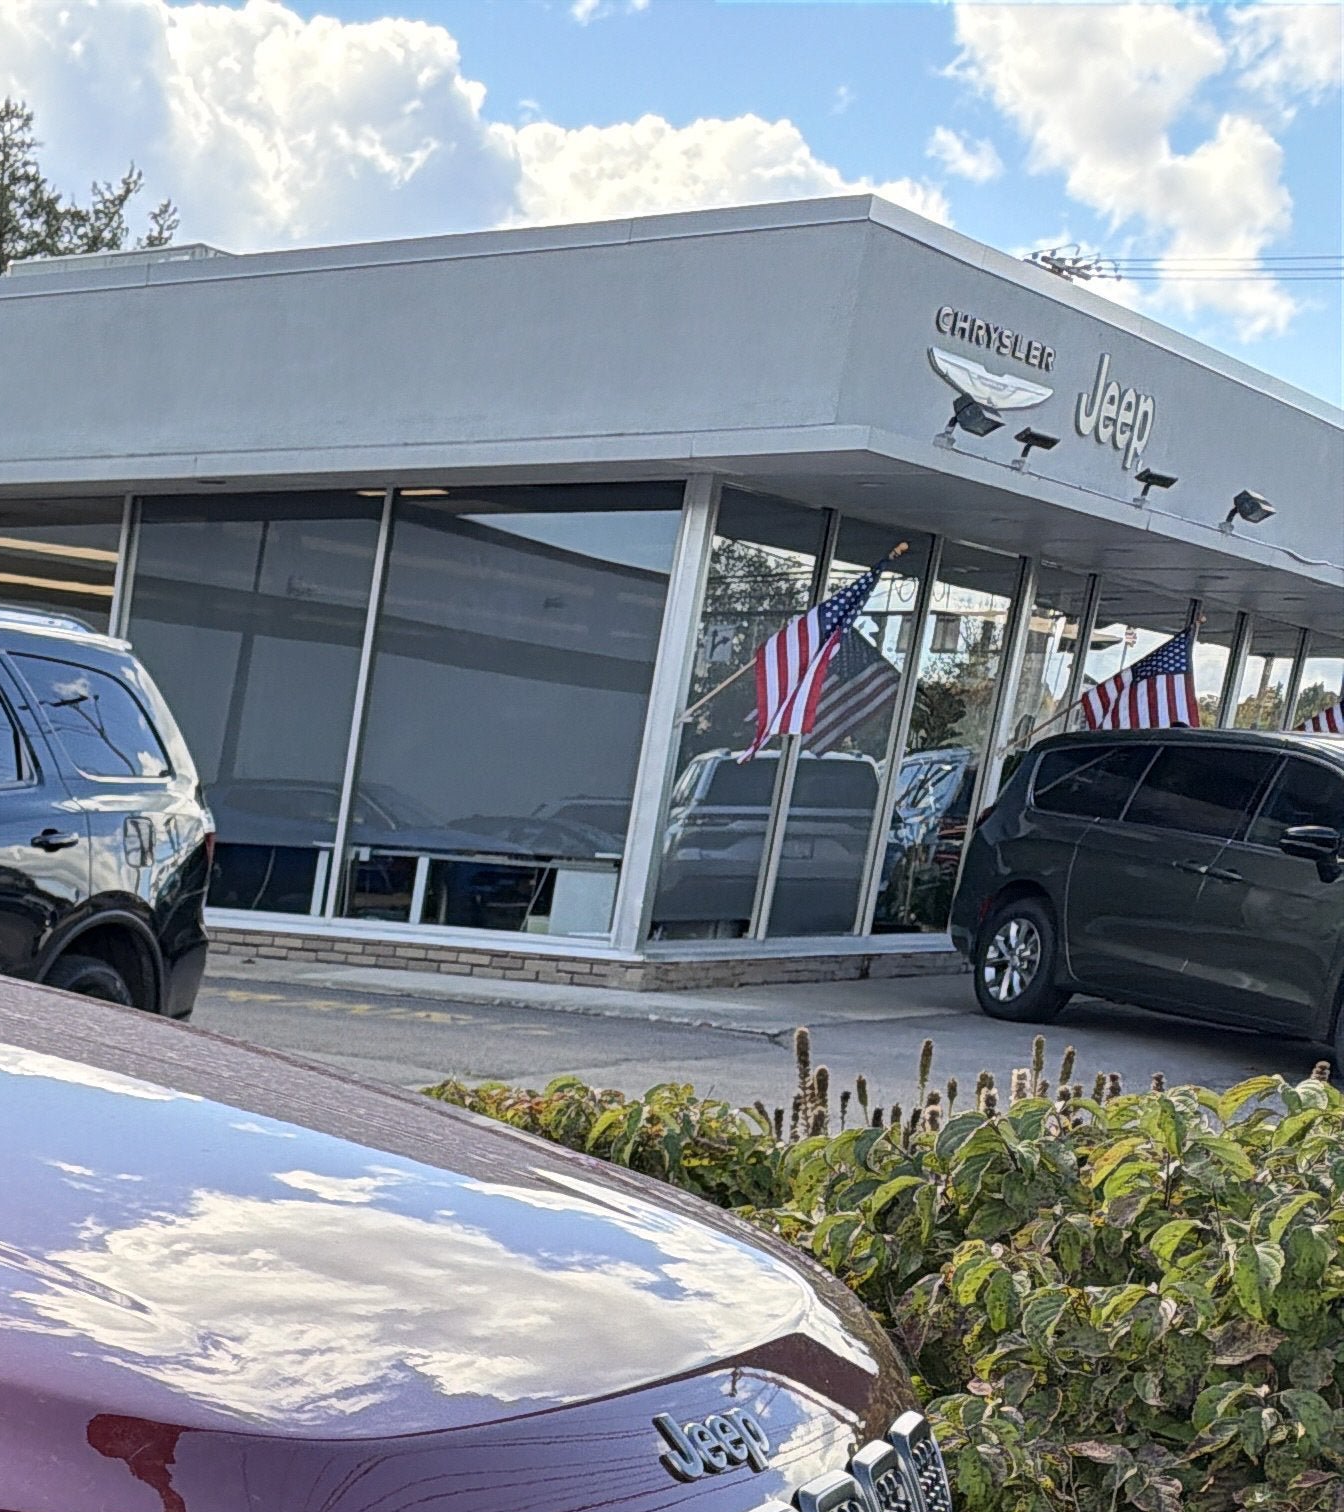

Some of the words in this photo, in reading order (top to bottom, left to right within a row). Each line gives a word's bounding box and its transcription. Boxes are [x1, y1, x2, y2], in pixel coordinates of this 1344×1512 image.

[936, 306, 1056, 372] CHRYSLER
[1075, 353, 1156, 469] Jeep
[652, 1411, 771, 1483] Jeep
